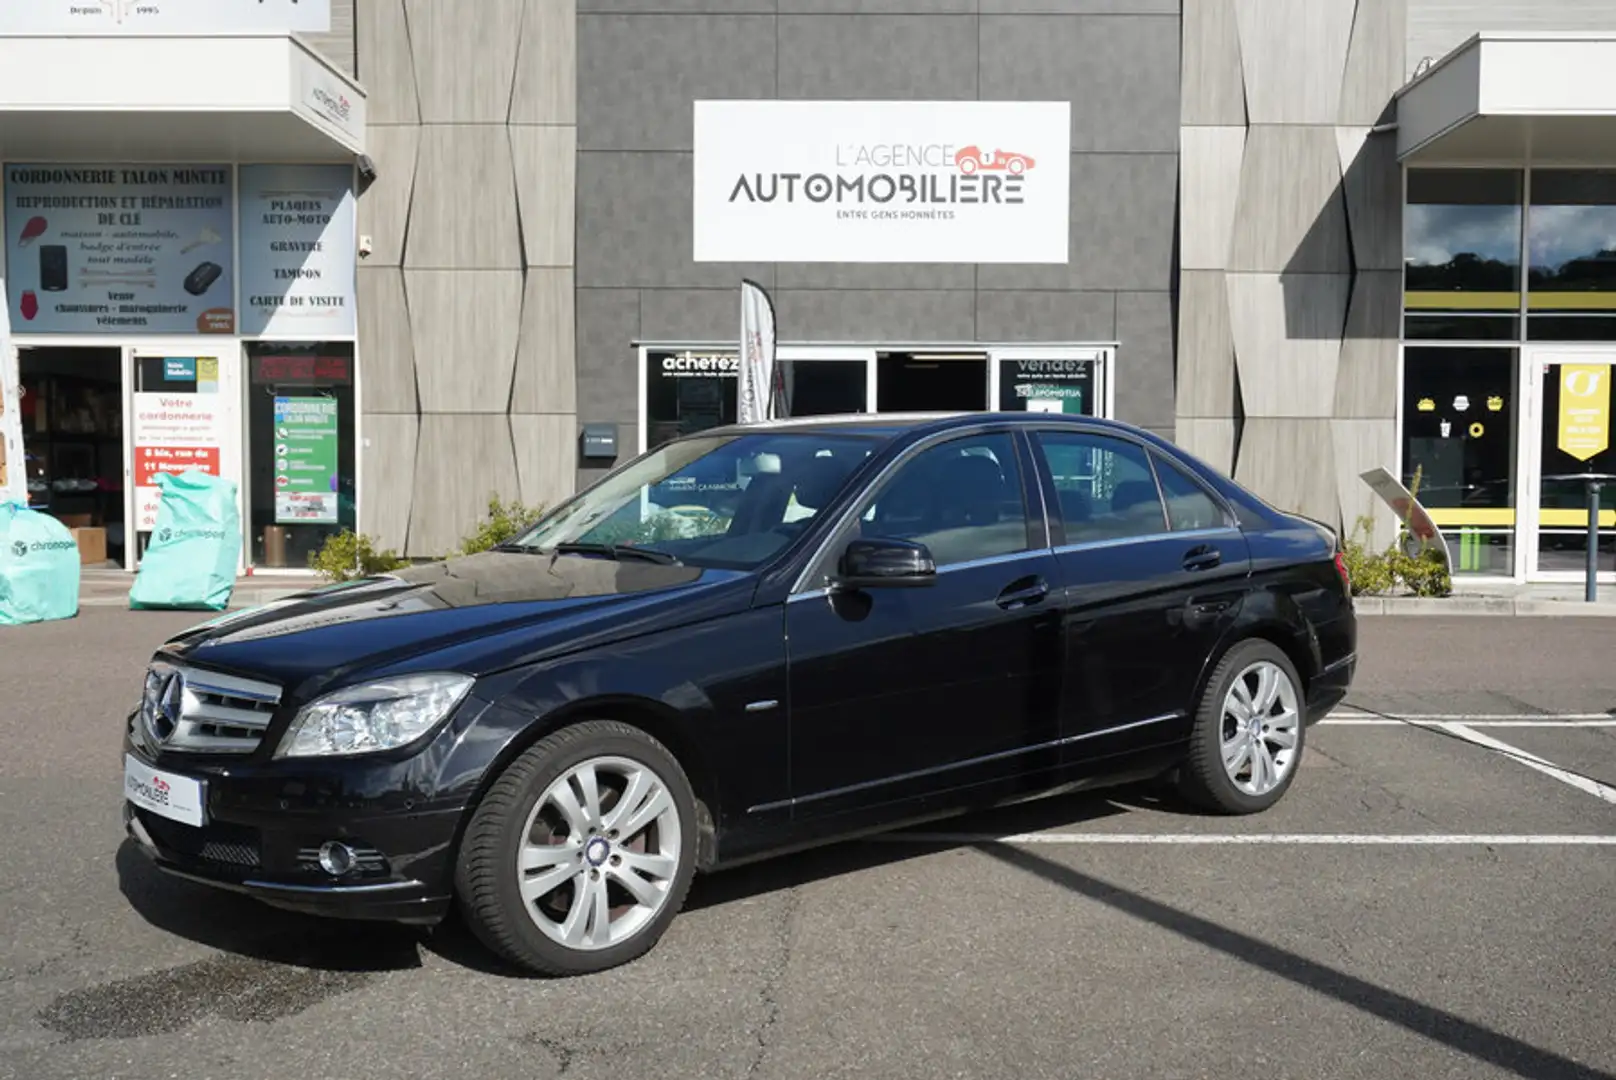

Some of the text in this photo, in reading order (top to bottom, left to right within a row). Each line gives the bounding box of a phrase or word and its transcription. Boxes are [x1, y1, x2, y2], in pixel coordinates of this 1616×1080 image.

[836, 144, 955, 167] L'AGENCE
[10, 168, 227, 185] CORDONNERIE TALON MINUTE
[15, 195, 117, 209] REPRODUCTION
[121, 195, 136, 209] ET
[271, 200, 322, 211] PLAQUES
[836, 207, 955, 219] ENTRE GENS HONNÊTES
[97, 212, 115, 226] DE
[262, 214, 331, 225] AUTO-MOTO
[80, 242, 114, 251] badge
[87, 256, 111, 264] tout
[273, 268, 322, 279] TAMPON
[108, 291, 136, 301] Vente
[249, 295, 345, 306] CARTE DE VISITE
[54, 303, 109, 313] chaussures
[118, 303, 188, 314] maroquinerie
[662, 351, 739, 370] achetez
[1017, 359, 1086, 371] vendez
[159, 398, 193, 408] Votre
[138, 411, 214, 421] cordonnerie
[174, 449, 193, 457] rue
[195, 448, 209, 458] du
